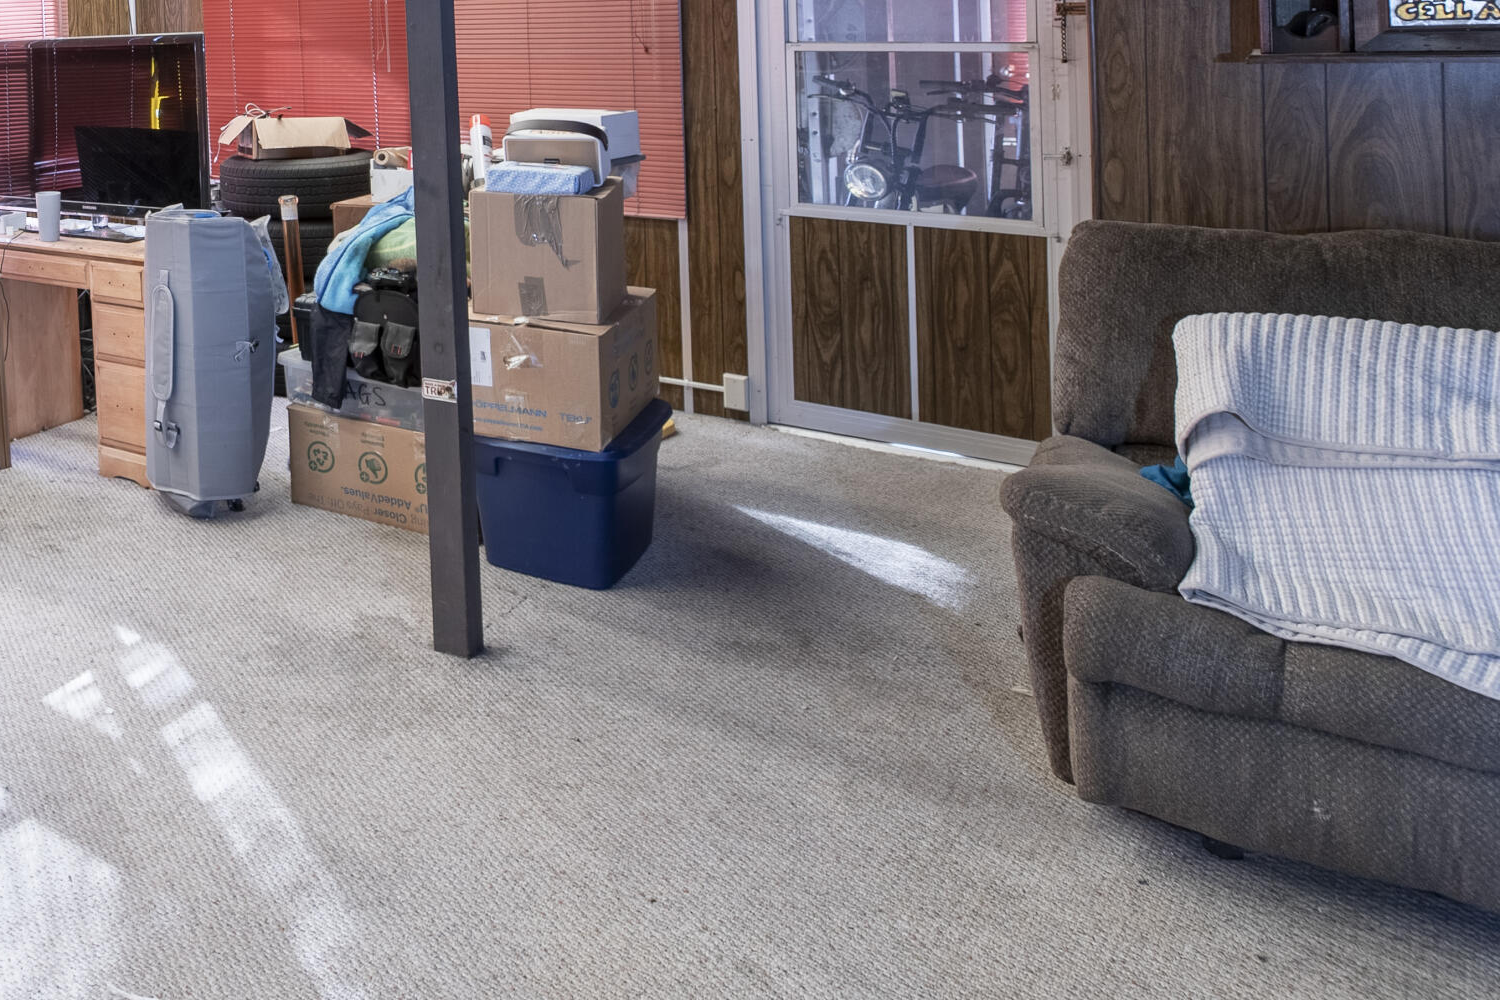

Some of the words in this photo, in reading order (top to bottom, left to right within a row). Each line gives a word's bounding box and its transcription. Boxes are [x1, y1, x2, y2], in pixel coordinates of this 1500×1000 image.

[1395, 0, 1500, 21] CELLA
[345, 381, 386, 407] AGS
[373, 507, 408, 524] Closer
